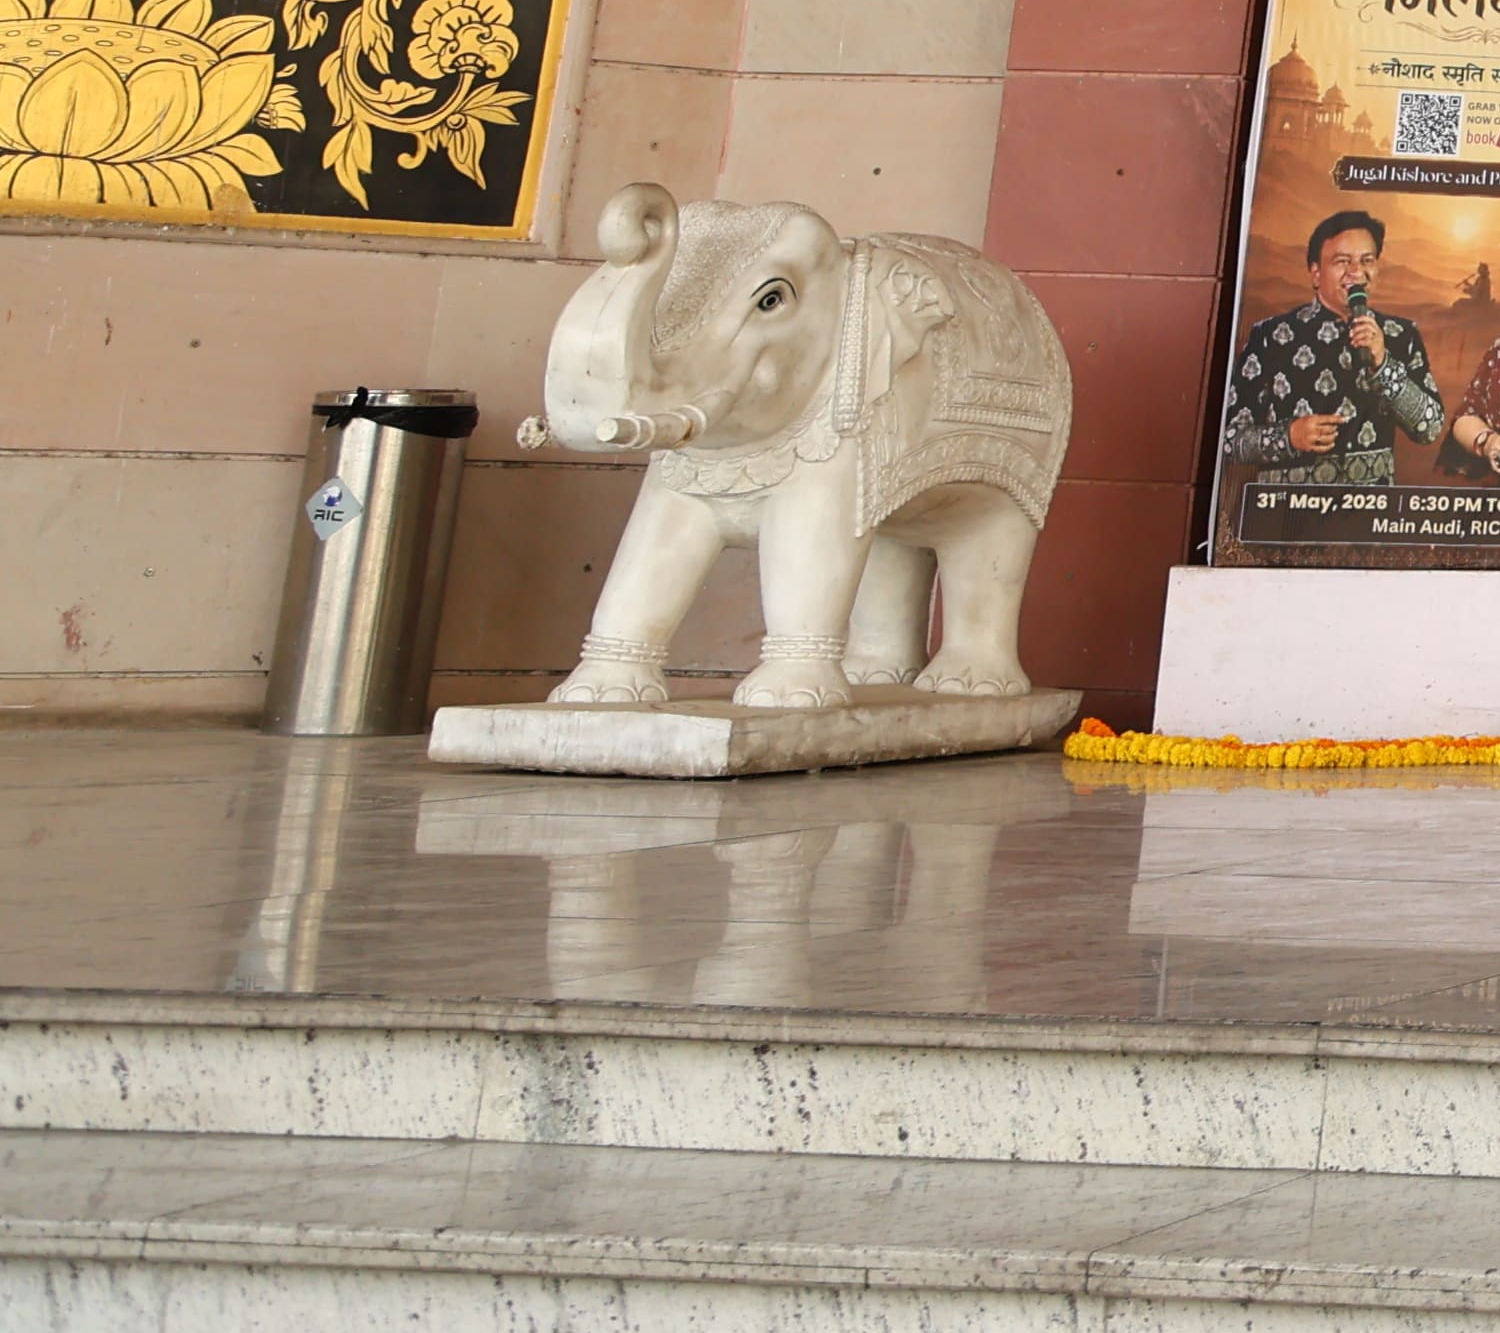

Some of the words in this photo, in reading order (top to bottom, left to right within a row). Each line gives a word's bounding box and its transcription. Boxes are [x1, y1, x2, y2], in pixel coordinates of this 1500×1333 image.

[1381, 58, 1435, 82] नौशाद
[1442, 62, 1484, 88] स्मृति
[1467, 100, 1496, 112] GRAB
[1466, 115, 1492, 125] NOW
[1345, 164, 1387, 185] Jugal
[1391, 166, 1452, 185] Kishore
[1455, 170, 1486, 186] and
[1257, 490, 1287, 508] 31st
[1290, 494, 1338, 513] May,
[1342, 494, 1388, 511] 2026
[1409, 495, 1449, 513] 6:30
[1454, 496, 1482, 513] PM
[314, 509, 344, 521] RIC
[1372, 518, 1416, 534] Main
[1420, 519, 1465, 538] Audi,
[1470, 521, 1500, 535] RIC
